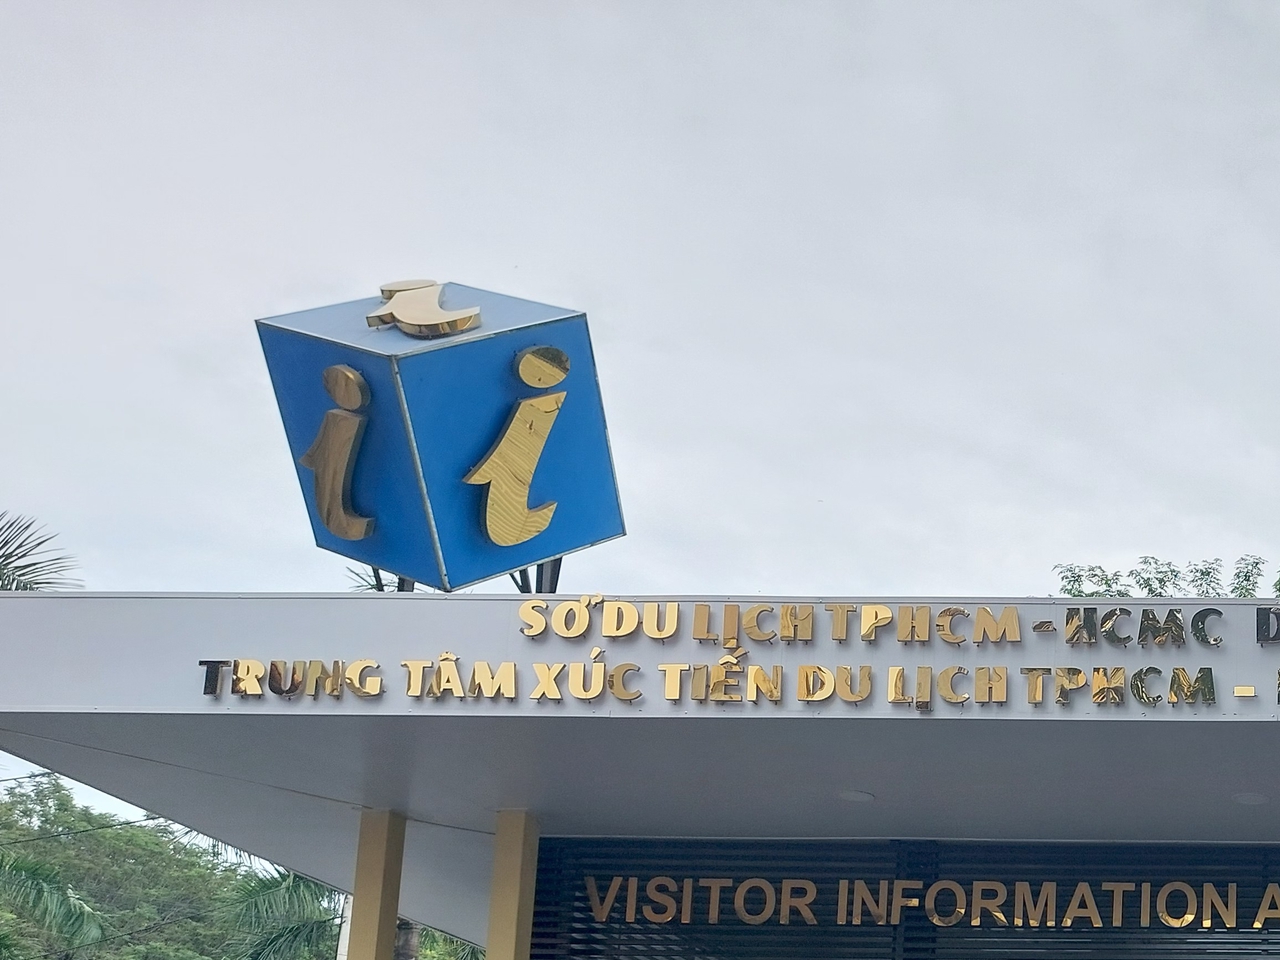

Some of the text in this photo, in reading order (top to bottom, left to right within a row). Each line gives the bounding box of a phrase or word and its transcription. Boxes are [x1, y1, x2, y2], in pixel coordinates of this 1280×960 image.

[519, 592, 604, 640] SỞ
[602, 600, 680, 640] DU
[692, 602, 814, 648] LỊCH
[824, 602, 1023, 645] TPHCM
[1065, 606, 1223, 647] HCMC
[198, 657, 386, 697] TRUNG
[400, 651, 517, 700] TÂM
[530, 647, 644, 702] XÚC
[657, 647, 784, 703] TIẾN
[798, 664, 872, 703] DU
[887, 665, 1009, 711] LỊCH
[1020, 665, 1217, 706] TPHCM
[583, 875, 818, 925] VISITOR
[836, 878, 1239, 928] INFORMATION
